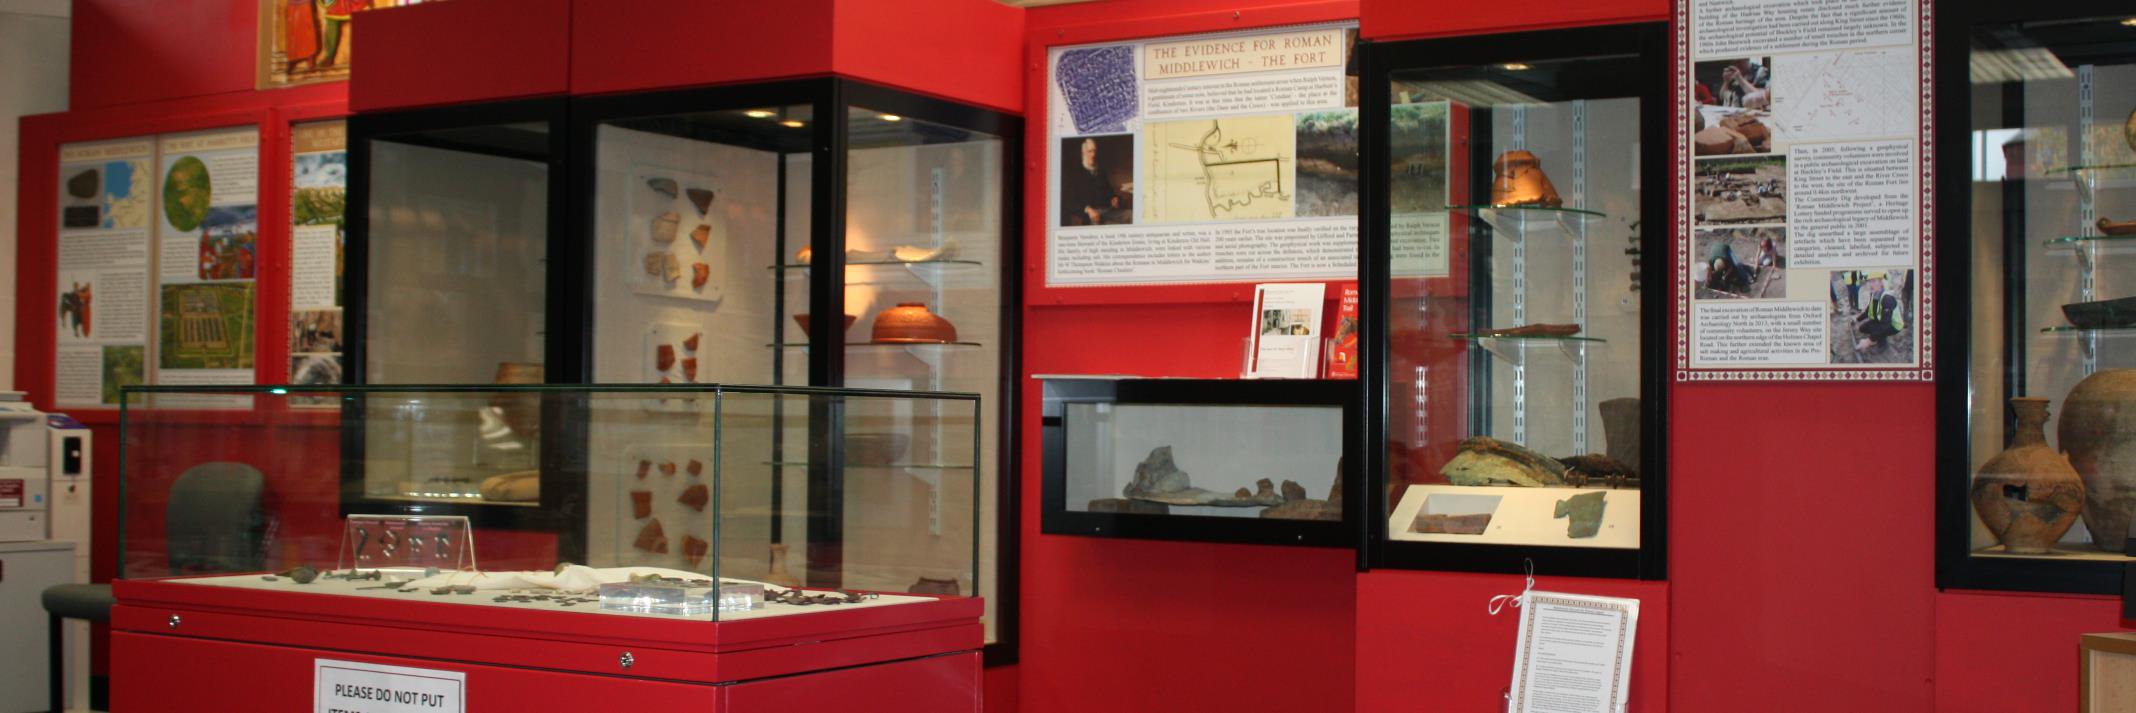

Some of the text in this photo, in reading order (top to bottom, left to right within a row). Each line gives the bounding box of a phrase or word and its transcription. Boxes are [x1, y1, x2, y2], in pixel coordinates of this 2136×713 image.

[1154, 34, 1332, 59] THE EVIDENCE FOR ROMAN
[1159, 58, 1240, 75] MIDDLEWICH
[1262, 55, 1285, 66] THE
[1294, 52, 1326, 64] FORT
[336, 684, 444, 708] PLEASE DO NOT PUT
